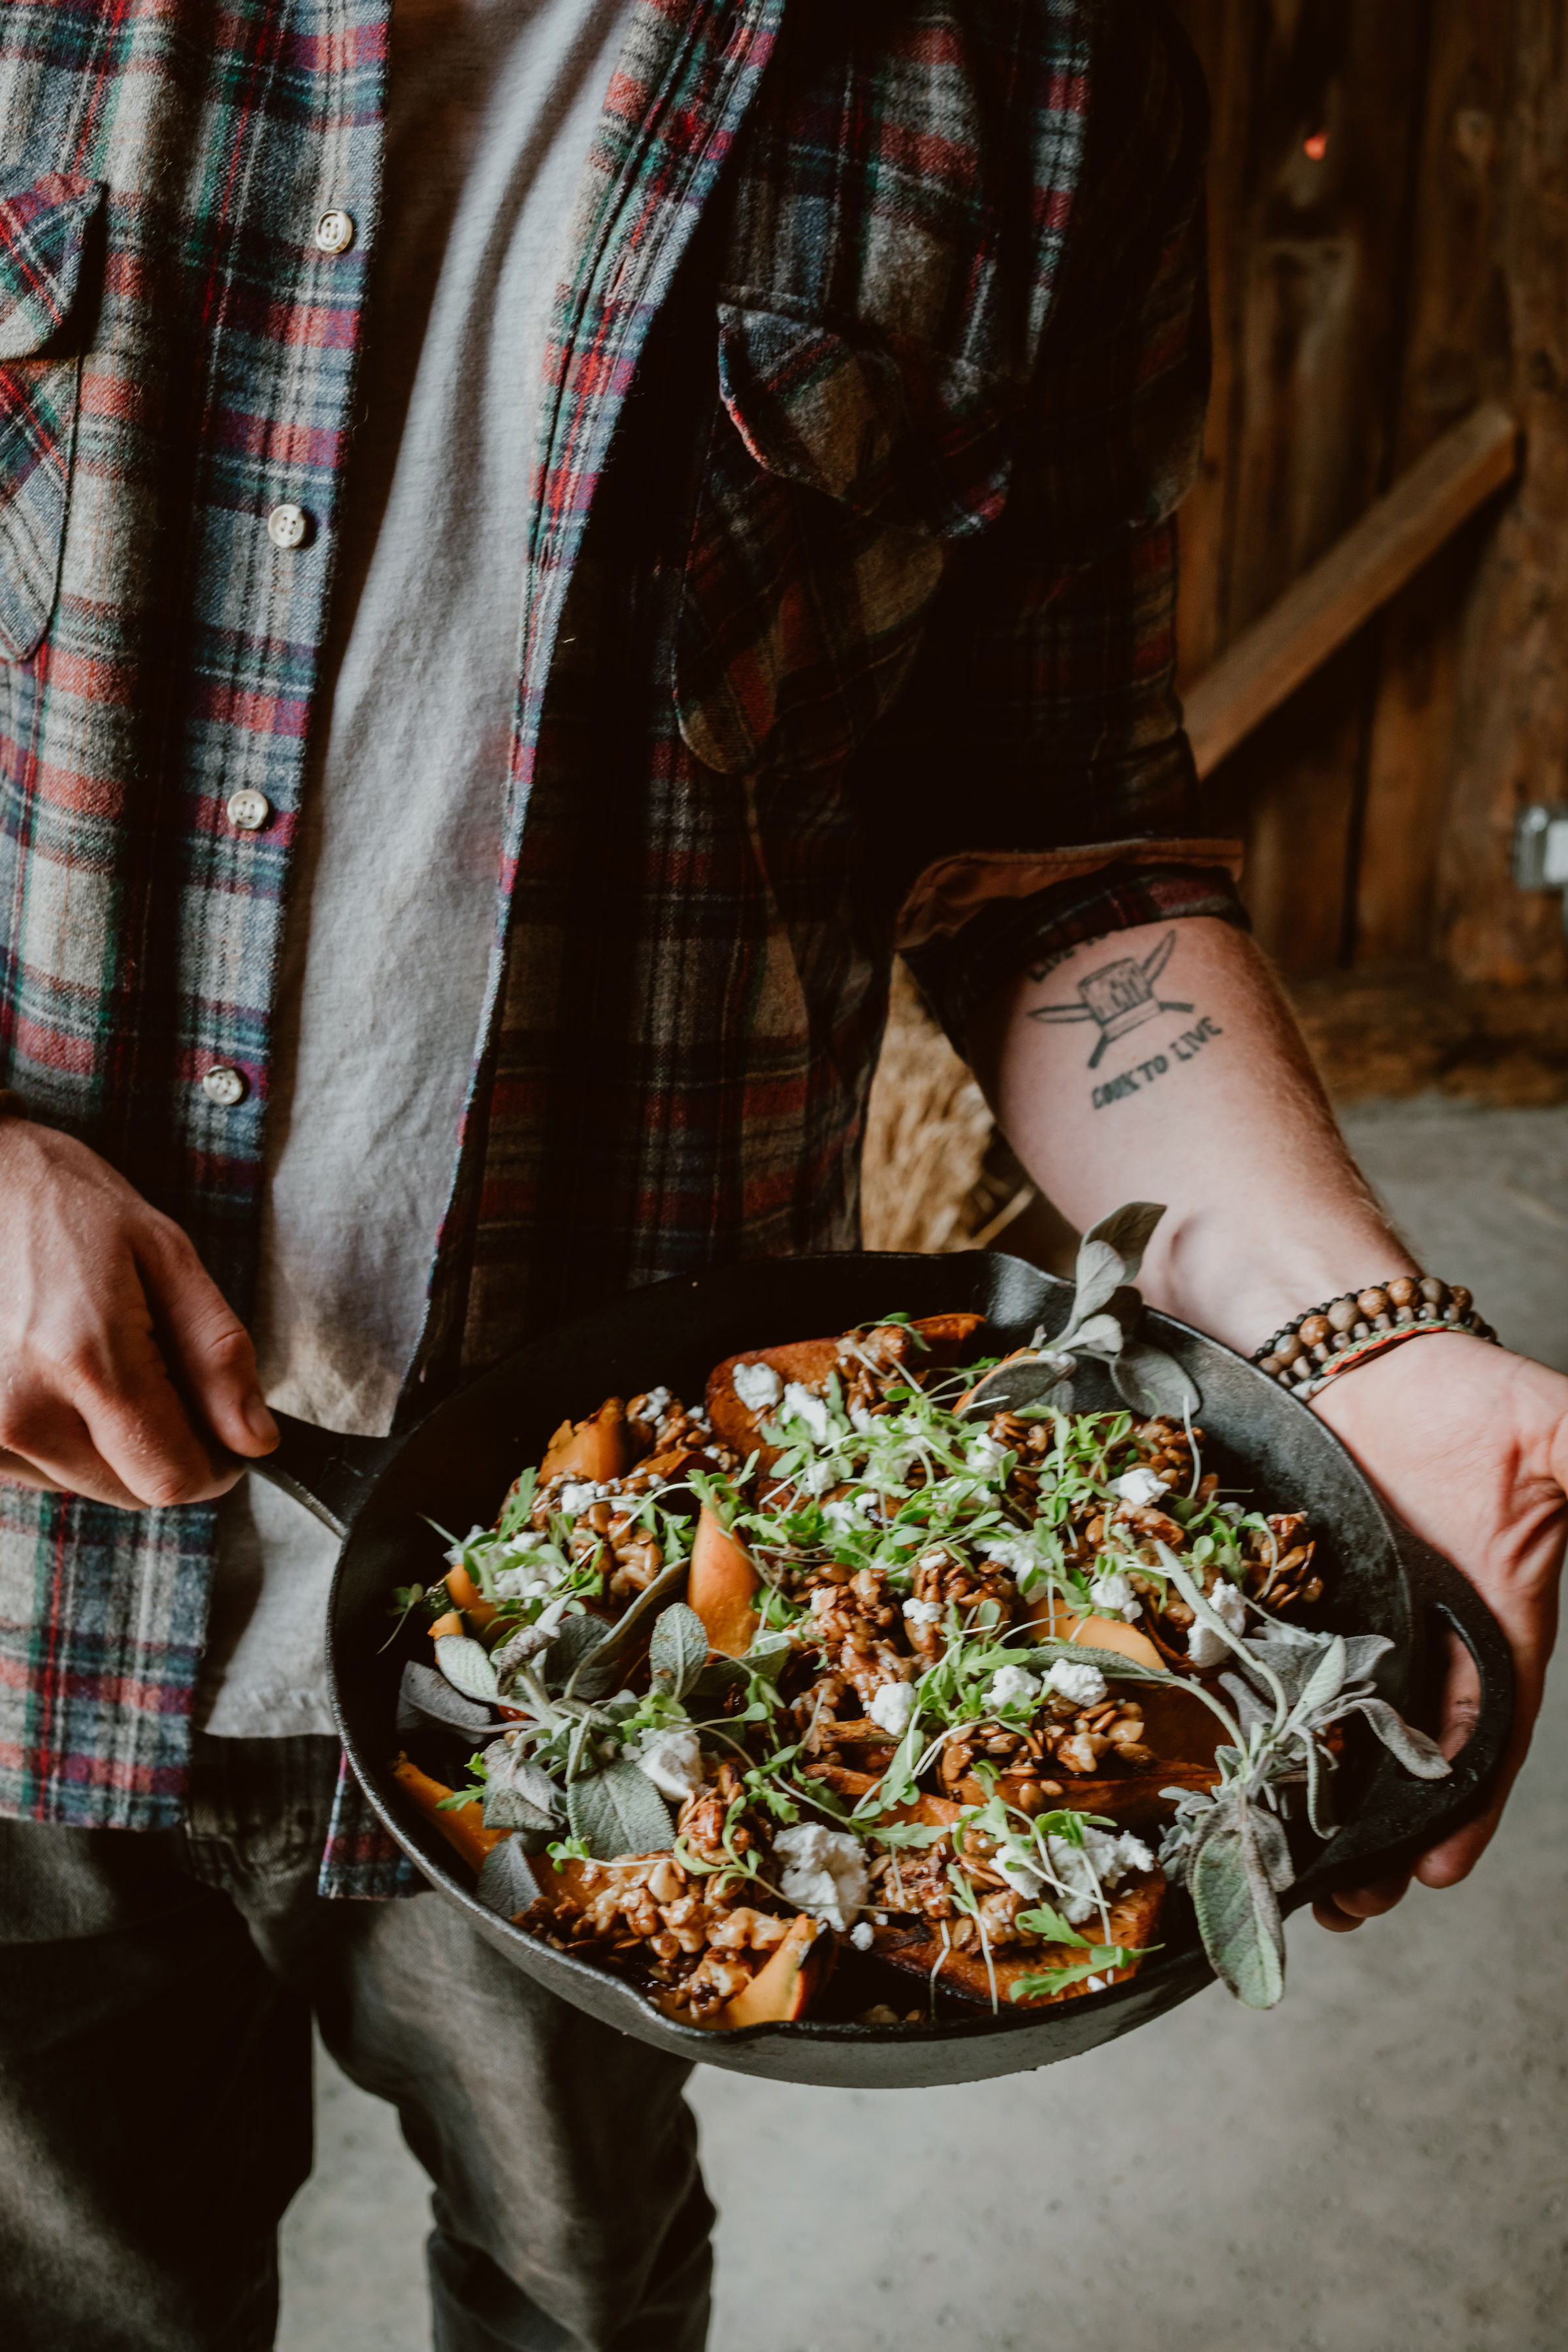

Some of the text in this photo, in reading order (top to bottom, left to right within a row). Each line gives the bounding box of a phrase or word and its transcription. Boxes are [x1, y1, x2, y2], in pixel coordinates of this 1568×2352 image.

[1092, 1017, 1223, 1109] COOK TO LIVE
